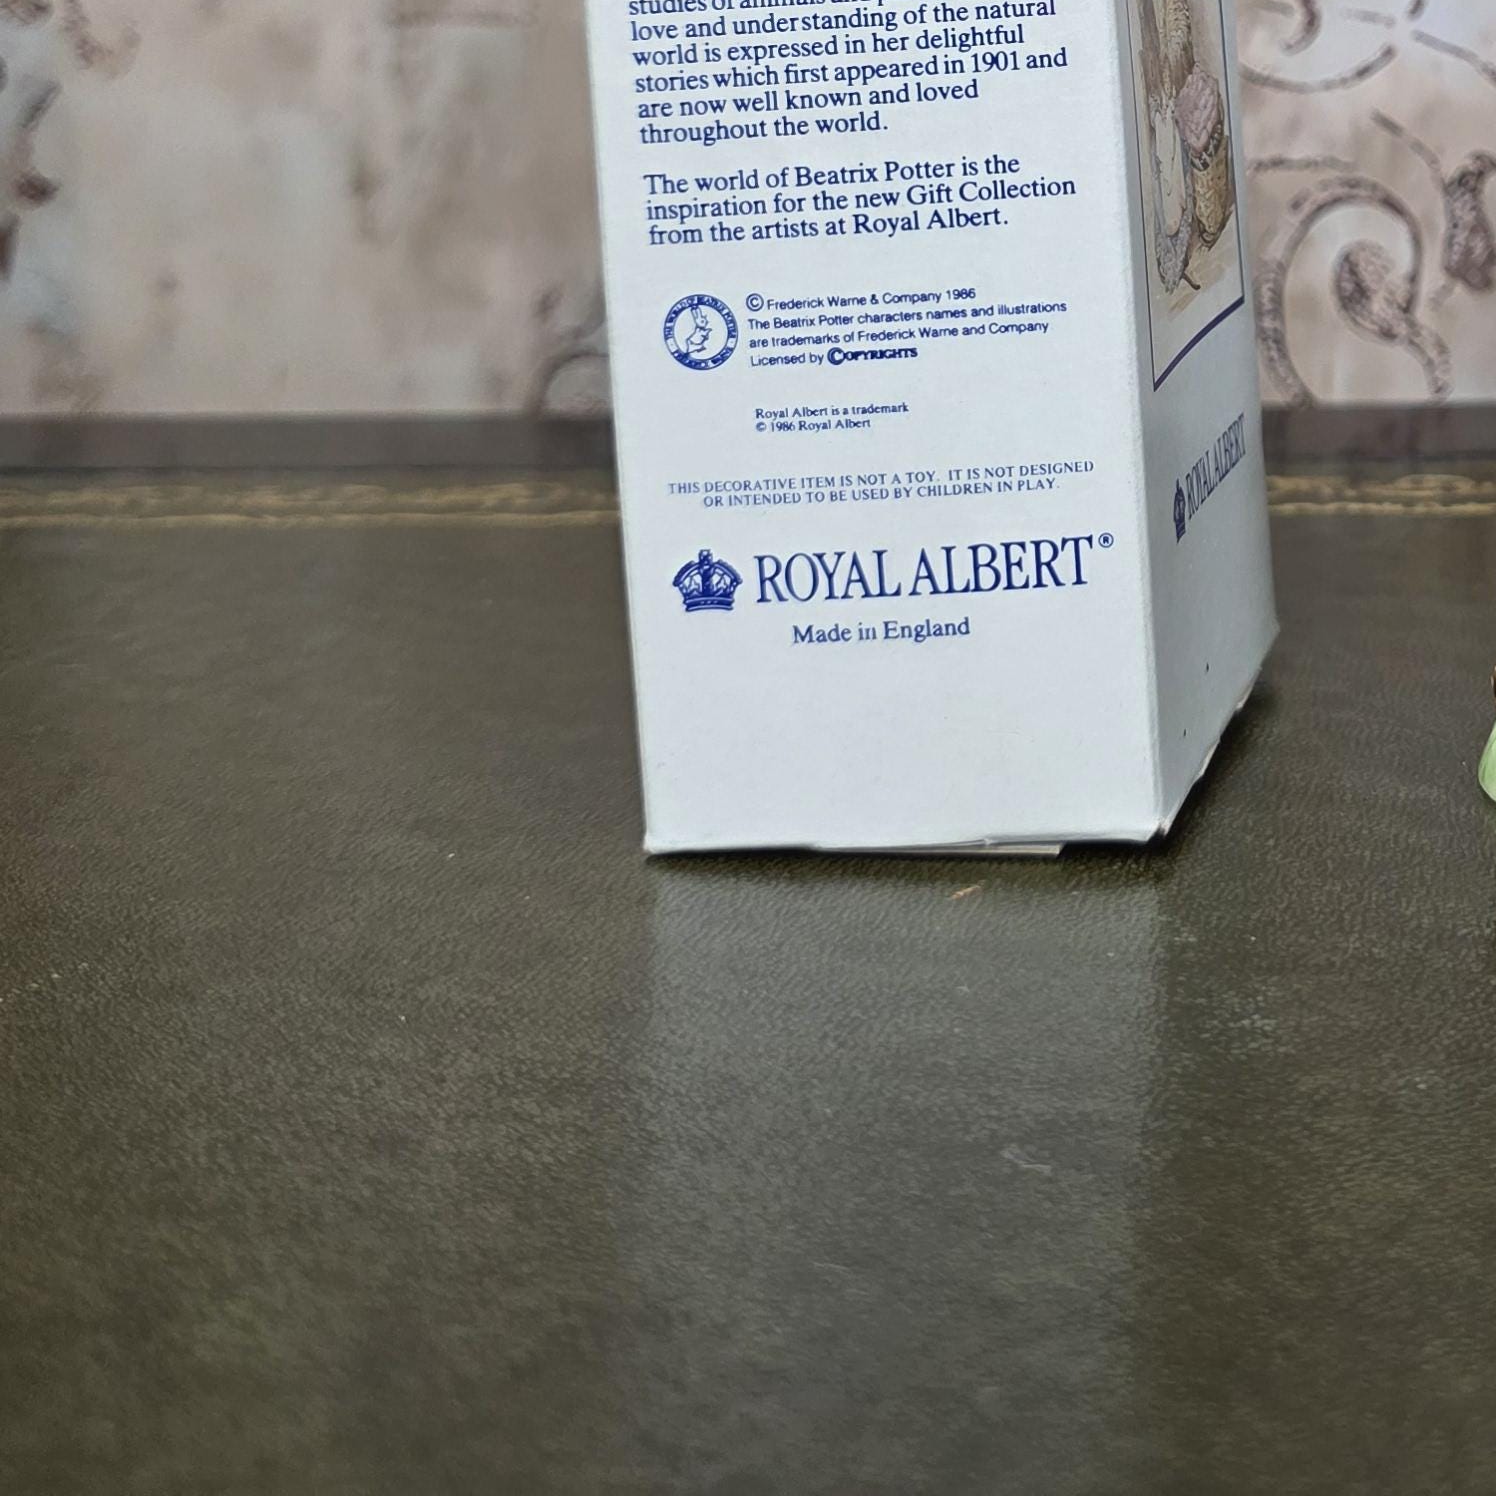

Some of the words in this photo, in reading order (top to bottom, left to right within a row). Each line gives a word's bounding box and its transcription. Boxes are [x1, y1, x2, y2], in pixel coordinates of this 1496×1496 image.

[631, 21, 678, 41] love
[685, 16, 726, 37] and
[732, 8, 898, 35] understanding
[903, 4, 927, 24] of
[933, 2, 969, 22] the
[632, 43, 698, 65] world
[704, 43, 721, 62] is
[728, 35, 838, 66] expressed
[845, 34, 866, 54] in
[872, 33, 909, 52] her
[916, 24, 1024, 53] delightful
[636, 70, 709, 93] stories
[712, 65, 780, 88] which
[784, 63, 829, 84] first
[835, 55, 939, 86] appeared
[944, 55, 965, 74] in
[971, 51, 1020, 73] 1901
[1026, 47, 1068, 69] and
[638, 103, 673, 118] are
[680, 100, 727, 116] now
[732, 91, 779, 112] well
[785, 90, 862, 110] known
[869, 83, 910, 105] and
[916, 79, 979, 102] loved
[640, 120, 768, 146] throughout
[774, 116, 809, 136] the
[815, 110, 888, 133] world.
[643, 174, 688, 195] The
[694, 169, 759, 191] world
[766, 167, 789, 188] of
[794, 163, 879, 187] Beatrix
[884, 161, 955, 181] Potter
[962, 156, 978, 176] is
[984, 154, 1020, 175] the
[647, 199, 767, 225] inspiration
[773, 192, 806, 213] for
[812, 190, 848, 211] the
[855, 192, 900, 208] new
[907, 183, 953, 205] Gift
[959, 177, 1076, 202] Collection
[649, 225, 703, 245] from
[709, 221, 745, 242] the
[752, 220, 819, 240] artists
[826, 218, 846, 235] at
[852, 210, 920, 237] Royal
[927, 208, 1008, 229] Albert.
[748, 319, 770, 329] The
[773, 317, 815, 329] Beatrix
[818, 315, 854, 326] Potter
[857, 312, 923, 324] characters
[926, 309, 967, 319] names
[971, 305, 994, 317] and
[998, 303, 1067, 315] illustrations
[767, 297, 824, 310] Frederick
[827, 296, 867, 307] Warne
[882, 292, 942, 305] Company
[946, 288, 976, 300] 1986
[749, 339, 768, 348] are
[772, 333, 840, 347] trademarks
[843, 331, 854, 343] of
[857, 329, 916, 341] Frederick
[918, 327, 959, 338] Warne
[962, 324, 985, 335] and
[989, 322, 1049, 334] Company
[751, 353, 806, 366] Licensed
[809, 352, 824, 365] by
[755, 408, 788, 421] Royal
[792, 407, 828, 417] Albert
[852, 402, 909, 415] trademark
[771, 421, 795, 432] 1986
[798, 419, 831, 433] Royal
[835, 418, 870, 429] Albert
[668, 482, 700, 494] THIS
[704, 478, 796, 493] DECORATIVE
[801, 477, 835, 488] ITEM
[840, 475, 853, 487] IS
[857, 474, 887, 486] NOT
[891, 473, 901, 484] A
[949, 469, 962, 481] IT
[967, 468, 980, 480] IS
[985, 466, 1014, 478] NOT
[1019, 461, 1093, 476] DESIGNED
[1185, 449, 1215, 521] ROYAL
[1212, 412, 1246, 487] ALBERT
[703, 496, 724, 507] OR
[729, 493, 801, 506] INTENDED
[805, 491, 825, 503] TO
[830, 490, 847, 502] BE
[852, 488, 889, 501] USED
[894, 487, 912, 499] BY
[917, 482, 992, 497] CHILDREN
[998, 481, 1012, 492] IN
[754, 550, 901, 603] ROYAL
[908, 534, 1093, 596] ALBERT
[793, 623, 852, 644] Made
[858, 622, 877, 641] in
[883, 617, 970, 643] England
